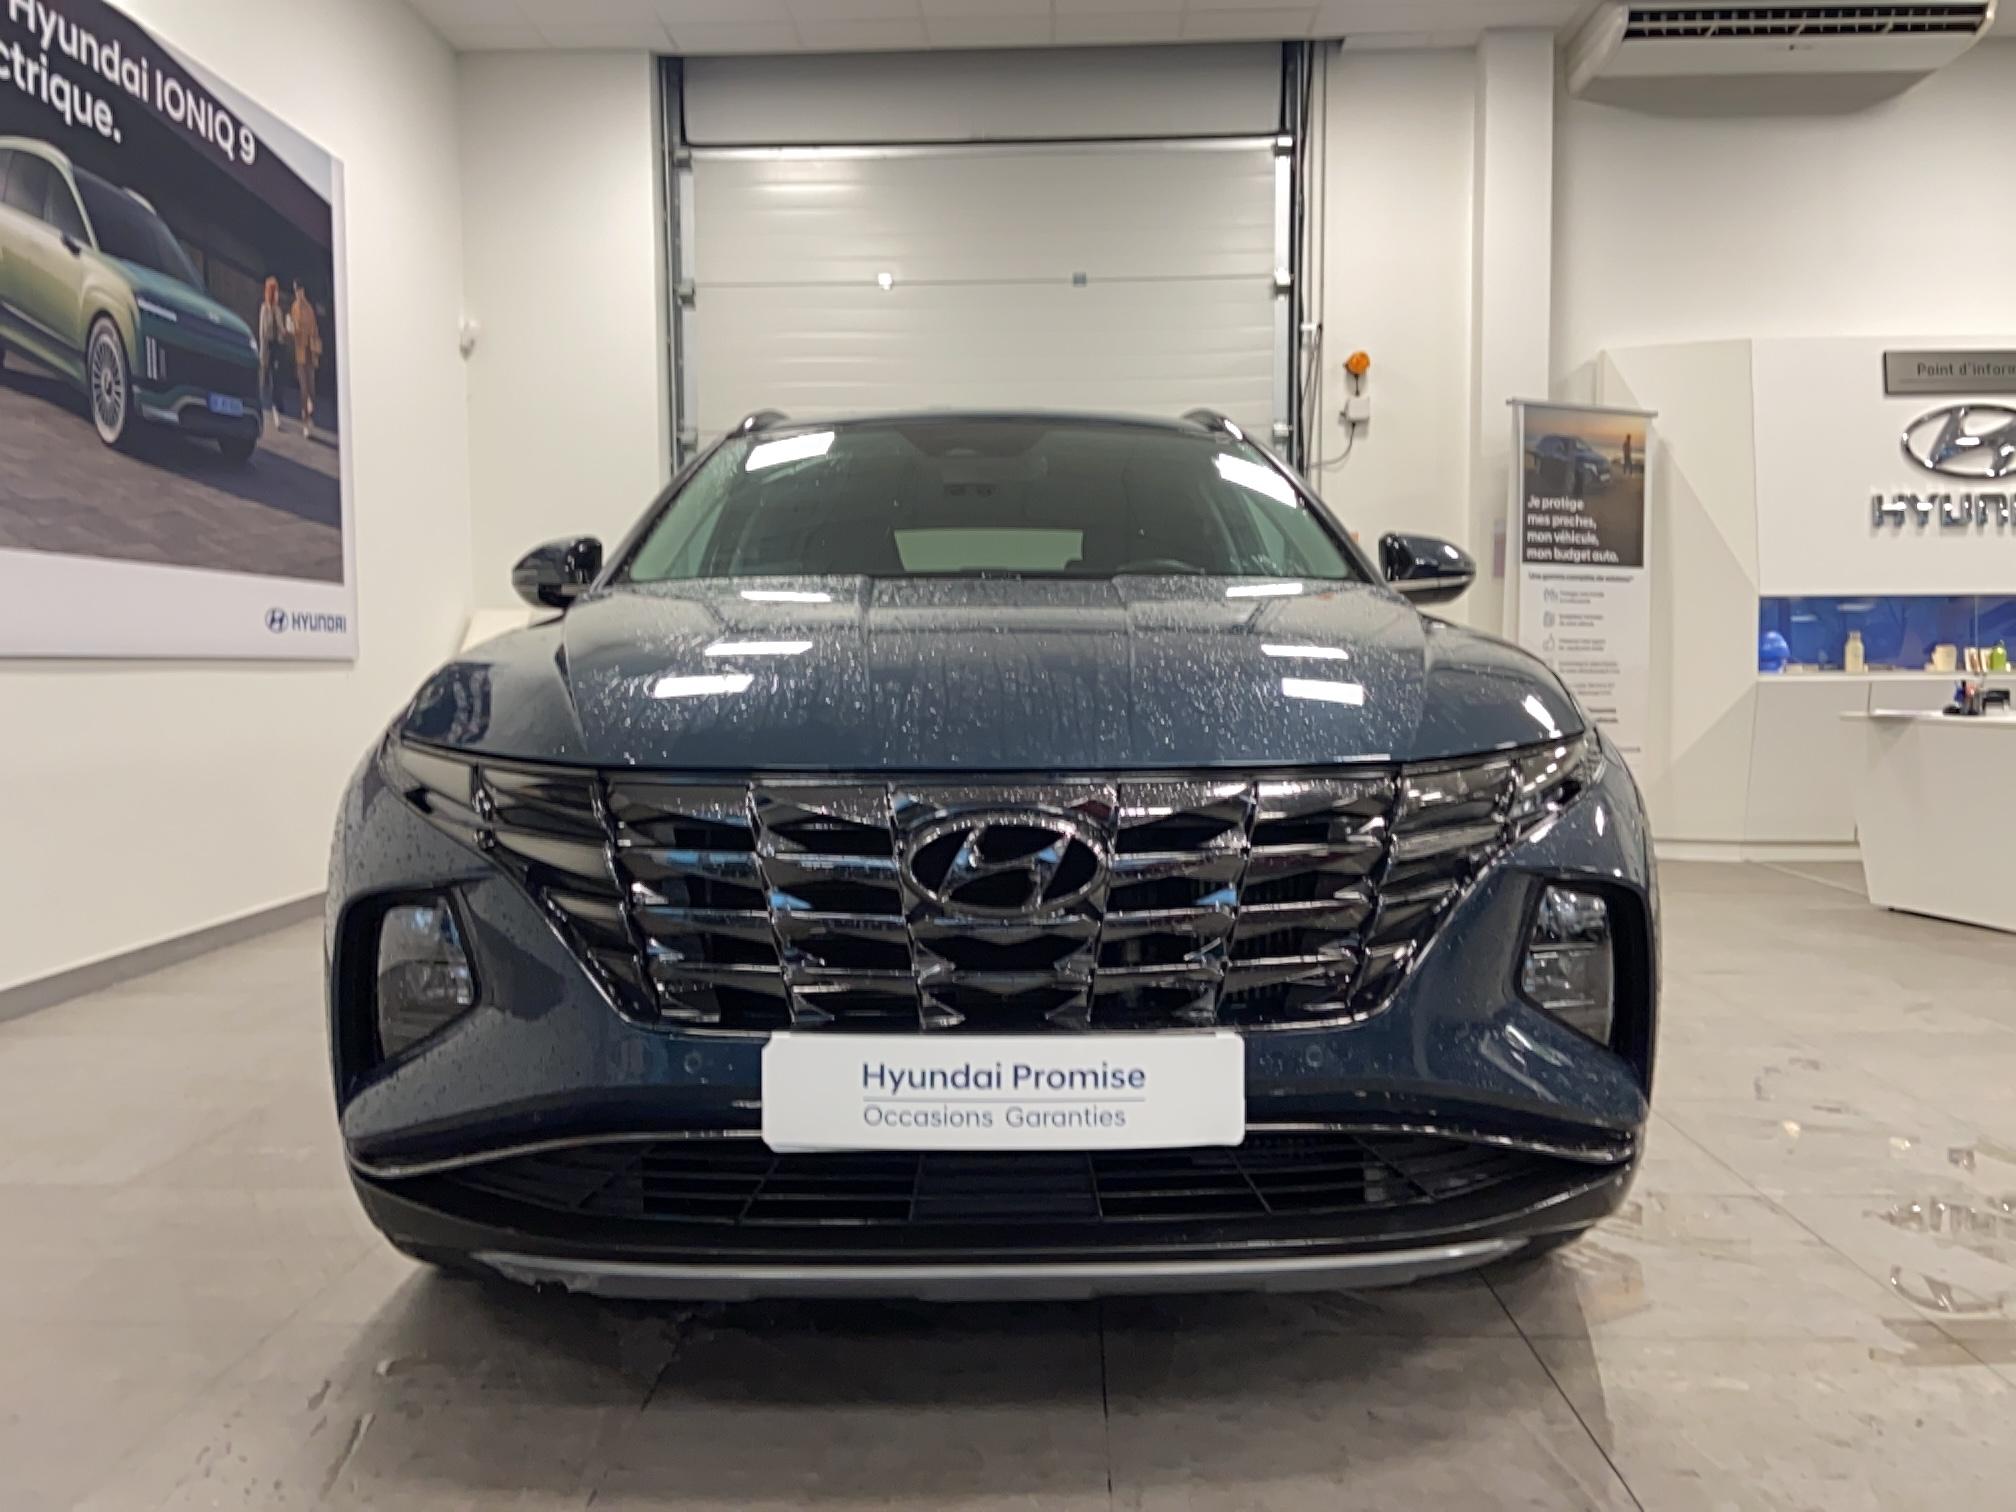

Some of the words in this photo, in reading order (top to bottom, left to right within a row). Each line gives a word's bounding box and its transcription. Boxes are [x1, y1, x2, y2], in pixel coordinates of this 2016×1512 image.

[9, 0, 149, 103] Hyundai
[155, 69, 235, 162] IONIQ
[239, 126, 256, 165] 9
[1917, 363, 1953, 376] Point
[1528, 495, 1541, 509] Je
[1528, 513, 1550, 526] mes
[1527, 531, 1552, 543] mon
[1526, 548, 1552, 560] mon
[1554, 546, 1591, 563] budget
[292, 612, 346, 633] HYUNDAI
[862, 1062, 1001, 1094] Hyundai
[1013, 1062, 1146, 1089] Promise
[863, 1103, 993, 1128] Occasions
[1006, 1105, 1126, 1128] Garanties
